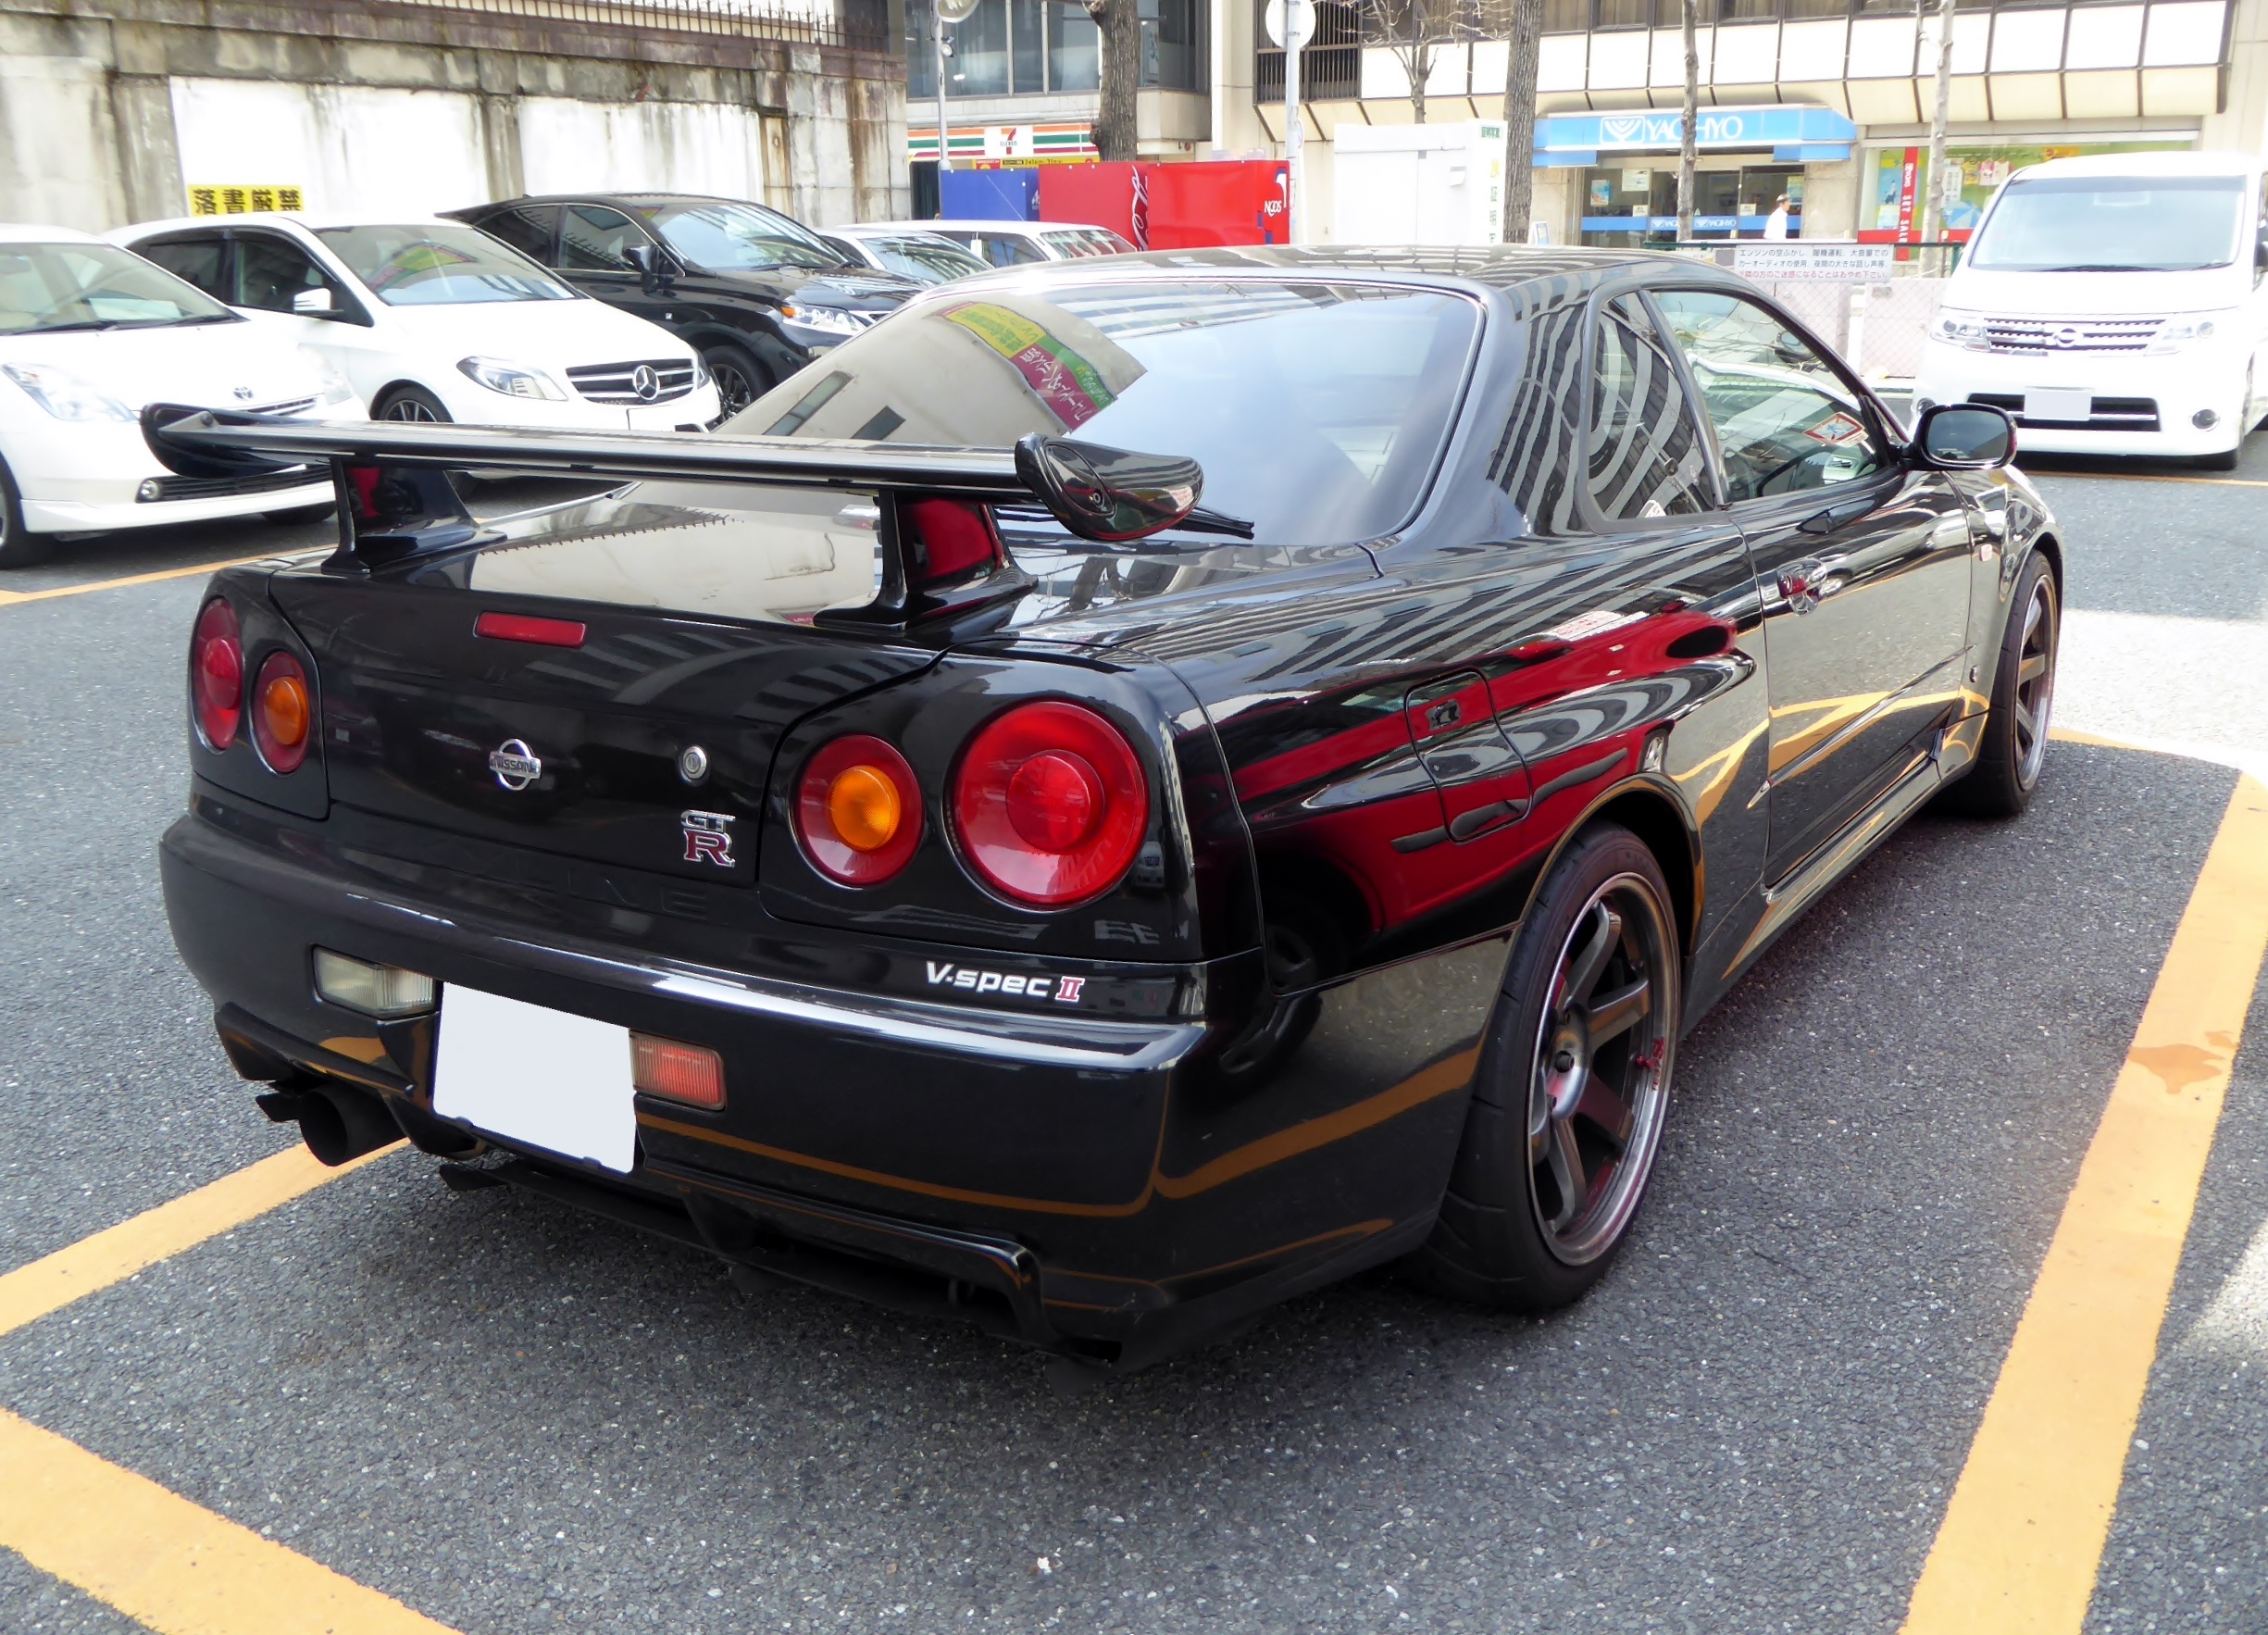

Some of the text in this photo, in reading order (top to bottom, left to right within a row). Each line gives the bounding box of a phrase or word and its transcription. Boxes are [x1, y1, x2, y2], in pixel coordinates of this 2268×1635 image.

[1646, 116, 1743, 141] YAGHYO
[193, 188, 301, 215] 落書厳禁
[492, 755, 536, 774] NISSAN
[680, 810, 736, 832] GT
[683, 829, 735, 867] R
